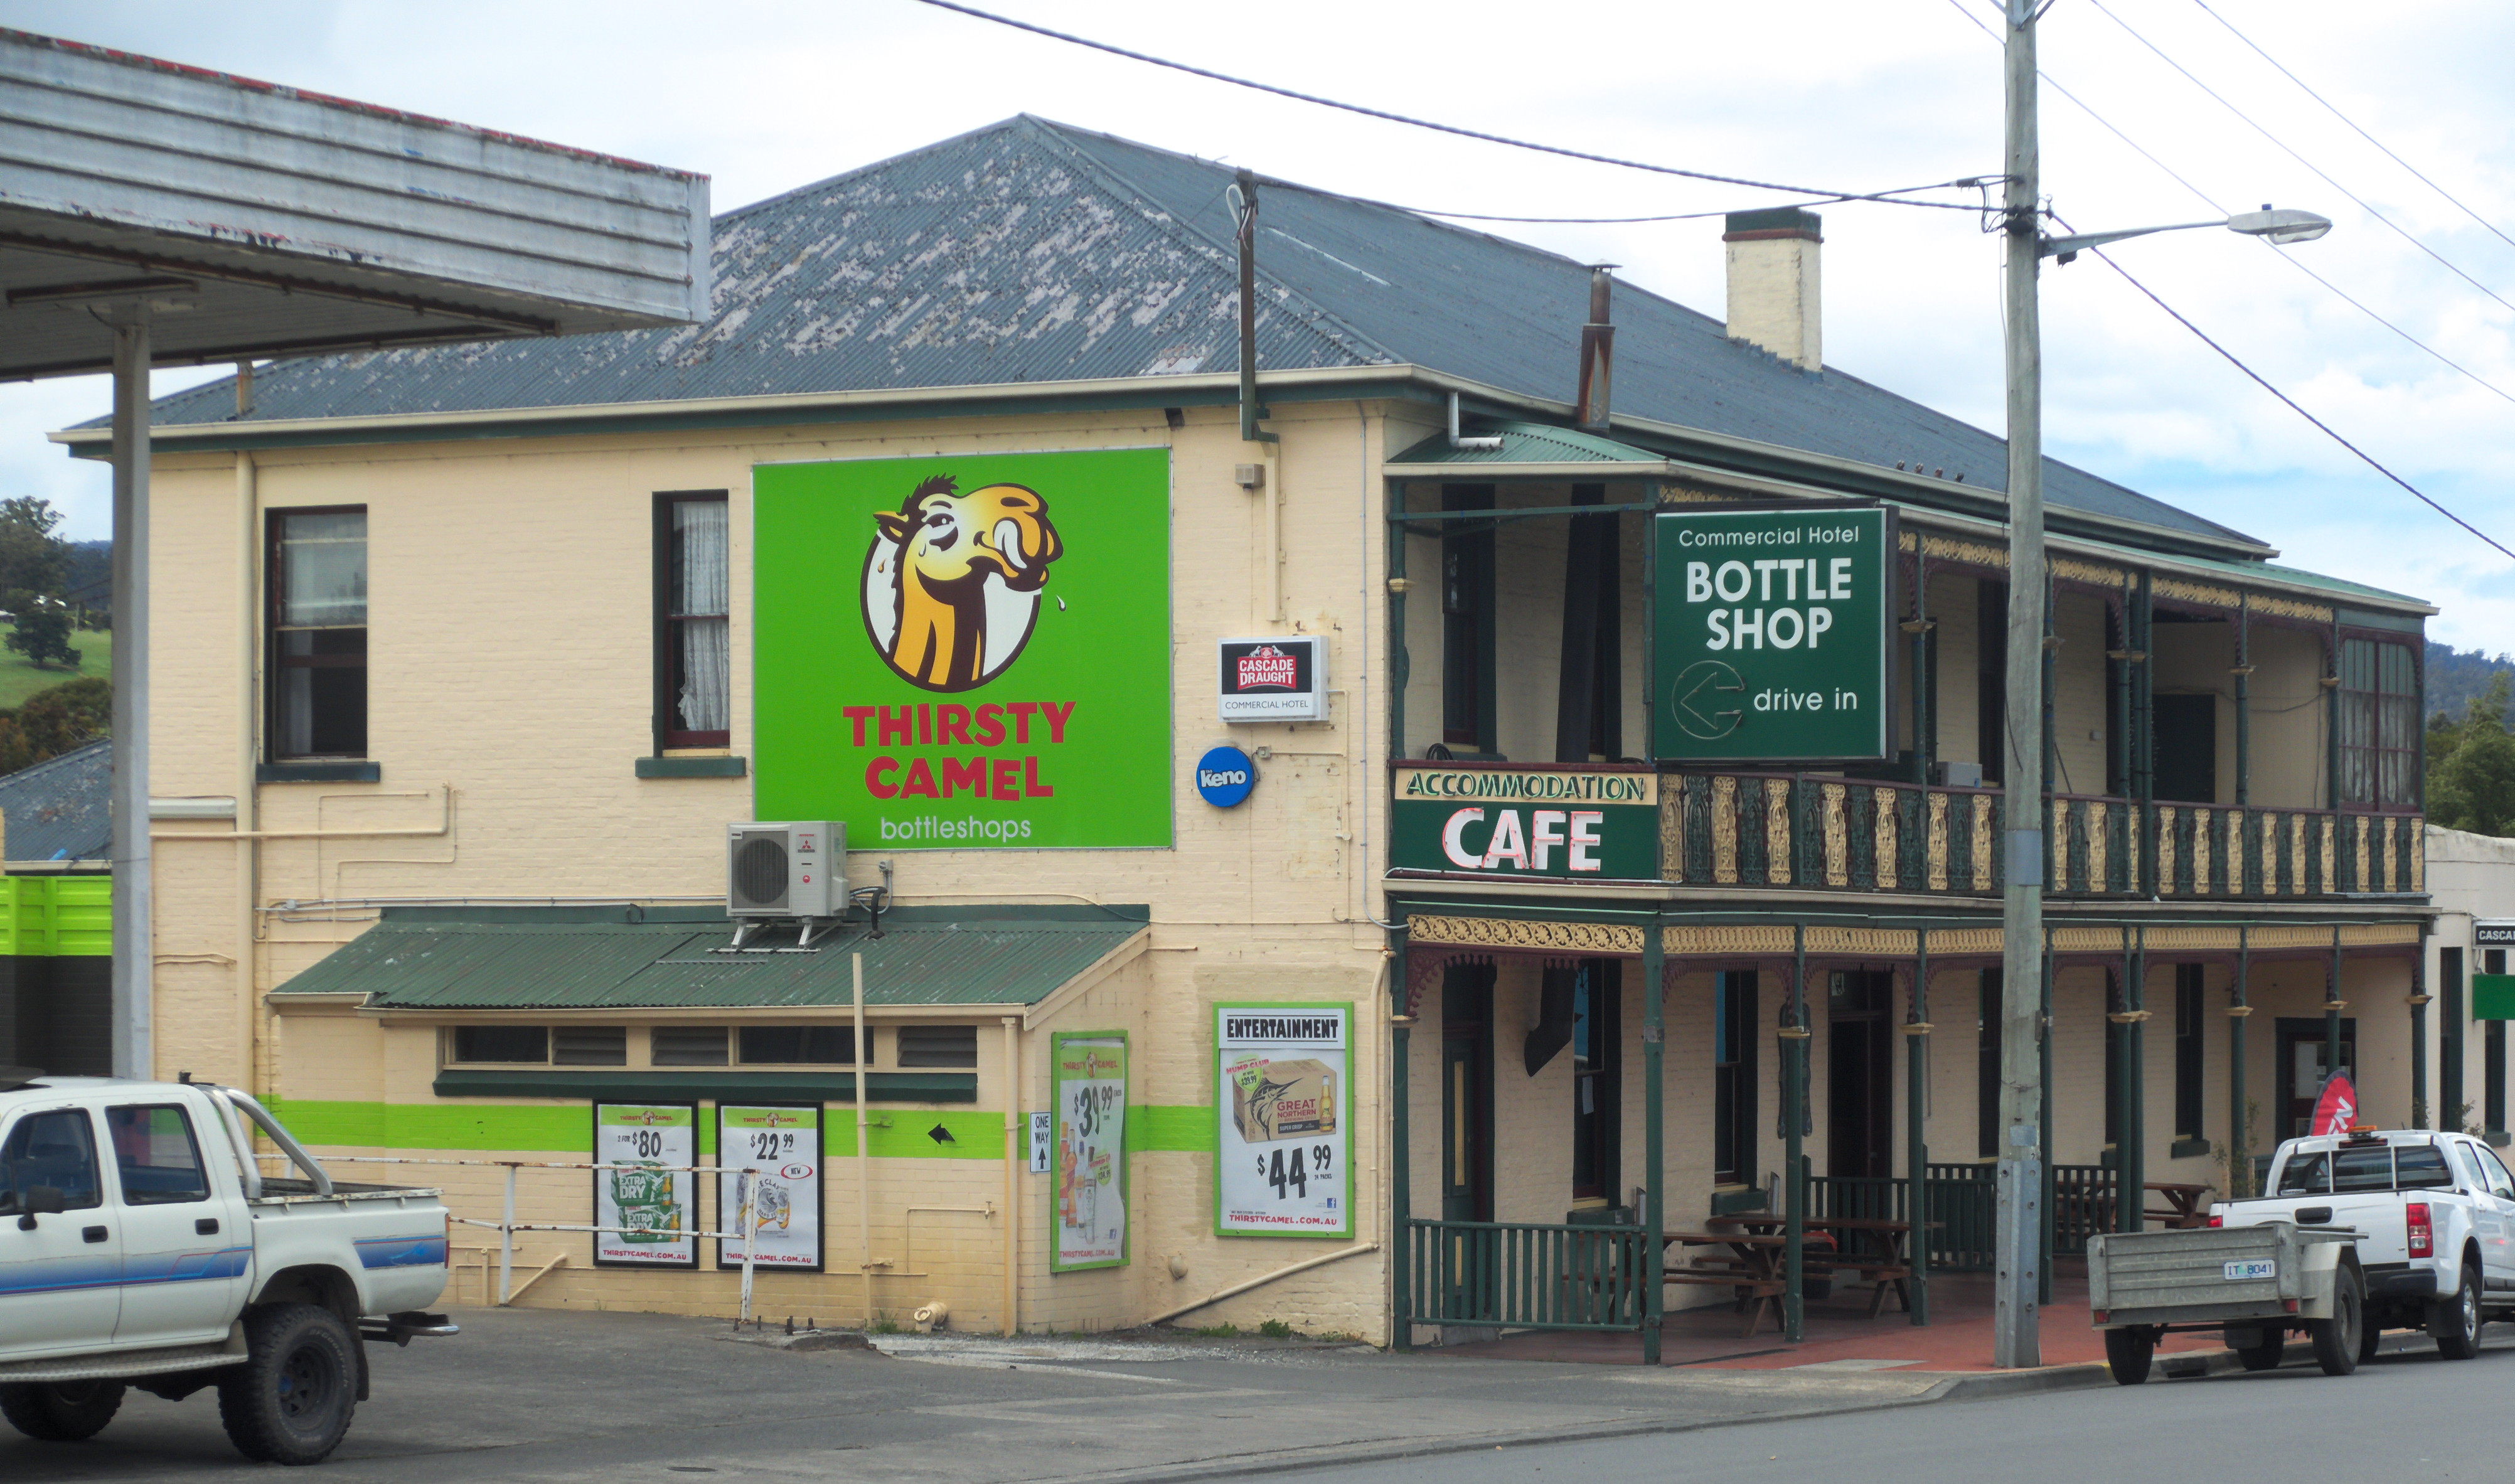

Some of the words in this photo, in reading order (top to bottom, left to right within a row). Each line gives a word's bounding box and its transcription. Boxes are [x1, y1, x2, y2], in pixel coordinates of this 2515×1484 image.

[1679, 526, 1800, 547] Commercial
[1808, 525, 1859, 543] Hotel
[1687, 557, 1852, 602] BOTTLE
[1706, 607, 1832, 651] SHOP
[1239, 659, 1294, 672] CASCADE
[1239, 671, 1294, 686] DRAUGHT
[1225, 700, 1279, 710] COMMERCIAL
[1281, 700, 1309, 708] HOTEL
[1754, 688, 1823, 711] drive
[1835, 687, 1857, 710] in
[842, 701, 1076, 747] THIRSTY
[864, 755, 1054, 801] CAMEL
[1200, 769, 1246, 787] keno
[1406, 771, 1645, 801] ACCOMMODATION
[880, 815, 1031, 843] bottleshops
[1441, 807, 1603, 871] CAFE
[1227, 1018, 1338, 1039] ENTERTAINMENT
[1063, 1061, 1085, 1070] THIRSTY
[1097, 1060, 1118, 1069] CAMEL
[1226, 1064, 1248, 1074] HUMP
[1250, 1059, 1269, 1069] CLUB
[1102, 1086, 1113, 1111] 99
[1277, 1099, 1316, 1111] GREAT
[1278, 1109, 1316, 1118] NORTHERN
[1035, 1116, 1049, 1128] ONE
[783, 1133, 793, 1148] 99
[1035, 1131, 1049, 1143] WAY
[1313, 1145, 1331, 1171] 99
[619, 1176, 646, 1185] EXTRA
[619, 1185, 646, 1199] DRY
[627, 1214, 653, 1222] EXTRA
[1229, 1214, 1337, 1225] THIRSTYCAMEL.COM.AU
[603, 1249, 686, 1260] THIRSTYCAMEL.COM.AU
[726, 1252, 811, 1264] THIRCAMEL.COM.AU
[1059, 1249, 1114, 1257] THIRSTYCAMEL.COM.AU
[2247, 1264, 2272, 1274] 8041
